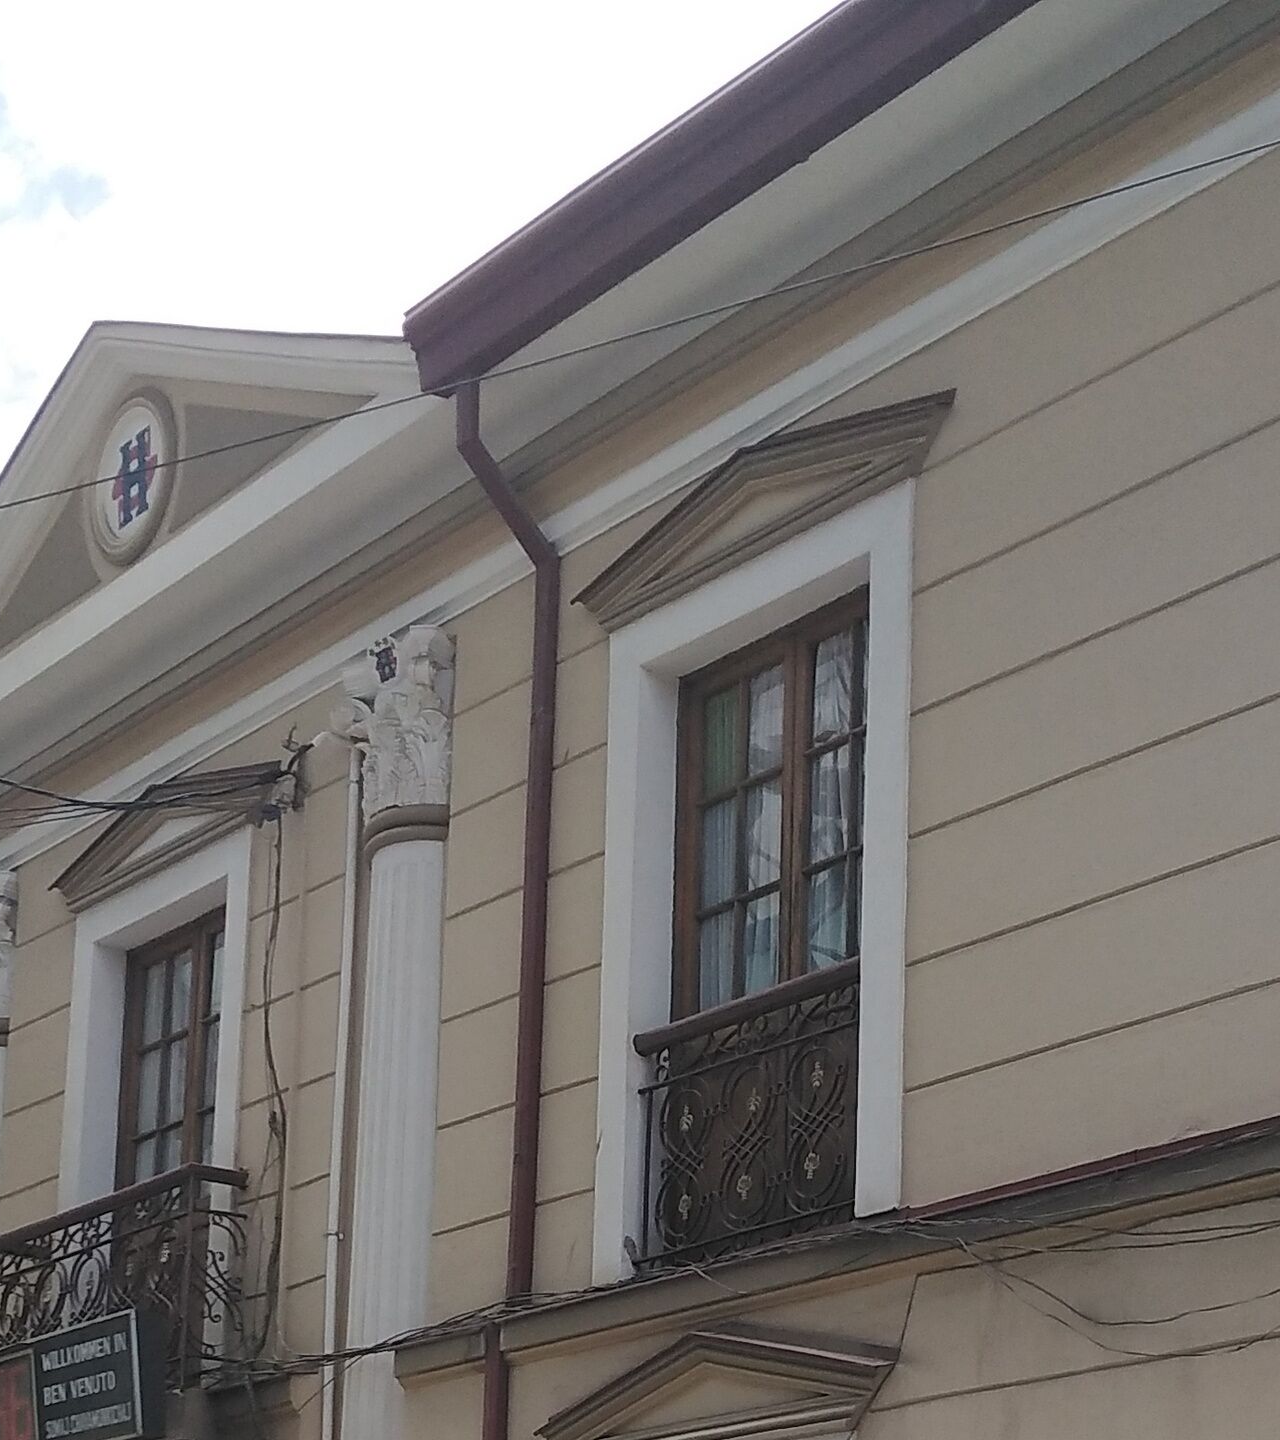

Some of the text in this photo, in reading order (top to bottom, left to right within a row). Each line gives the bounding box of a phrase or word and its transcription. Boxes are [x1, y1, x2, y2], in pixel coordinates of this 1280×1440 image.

[41, 1331, 128, 1372] WILLKOMMEN IN
[43, 1370, 117, 1406] BEN VENUTO
